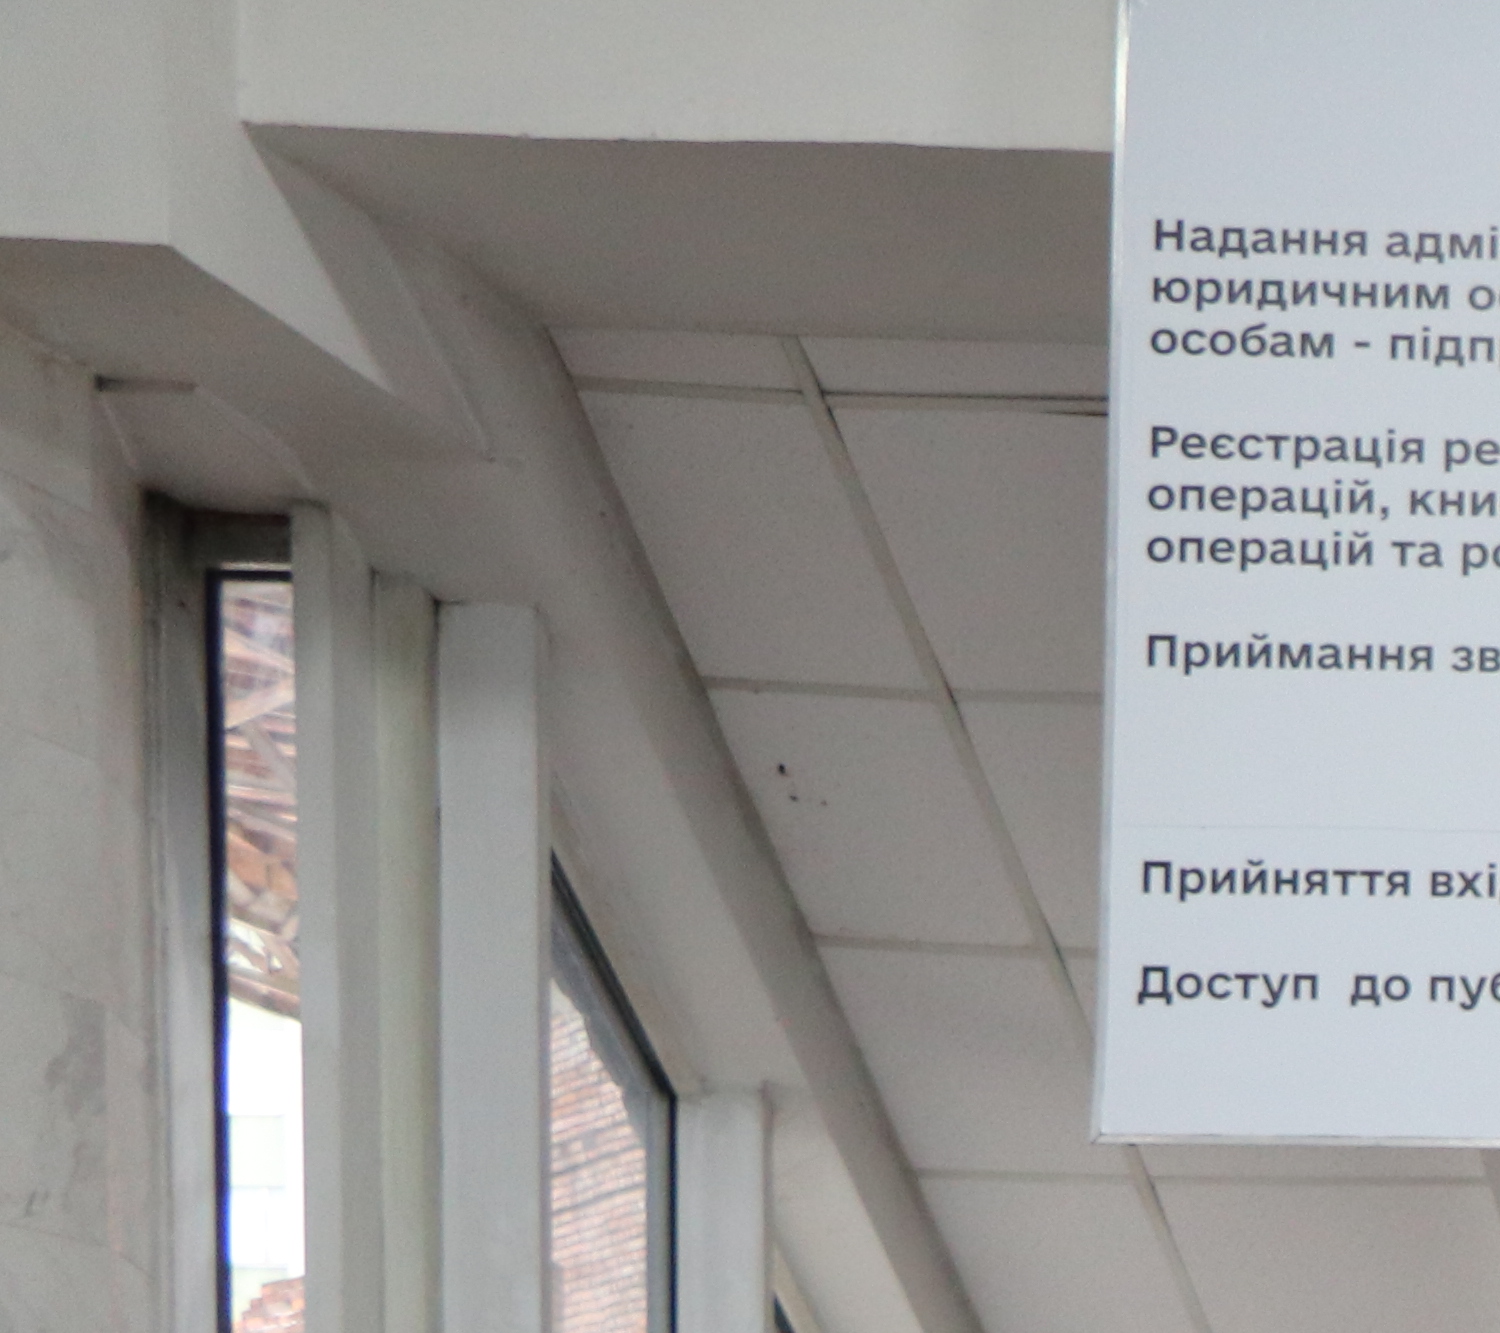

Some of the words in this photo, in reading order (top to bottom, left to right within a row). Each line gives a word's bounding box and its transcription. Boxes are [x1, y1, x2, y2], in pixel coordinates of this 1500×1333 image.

[1154, 218, 1367, 259] Надання
[1152, 277, 1449, 312] юридичним
[1150, 322, 1334, 358] особам
[1150, 425, 1424, 469] Реєстрація
[1147, 479, 1389, 521] операцій,
[1146, 531, 1373, 572] операцій
[1391, 541, 1443, 568] та
[1147, 633, 1433, 676] Приймання
[1142, 859, 1411, 903] Прийняття
[1136, 965, 1319, 1009] Доступ
[1349, 974, 1411, 1007] до
